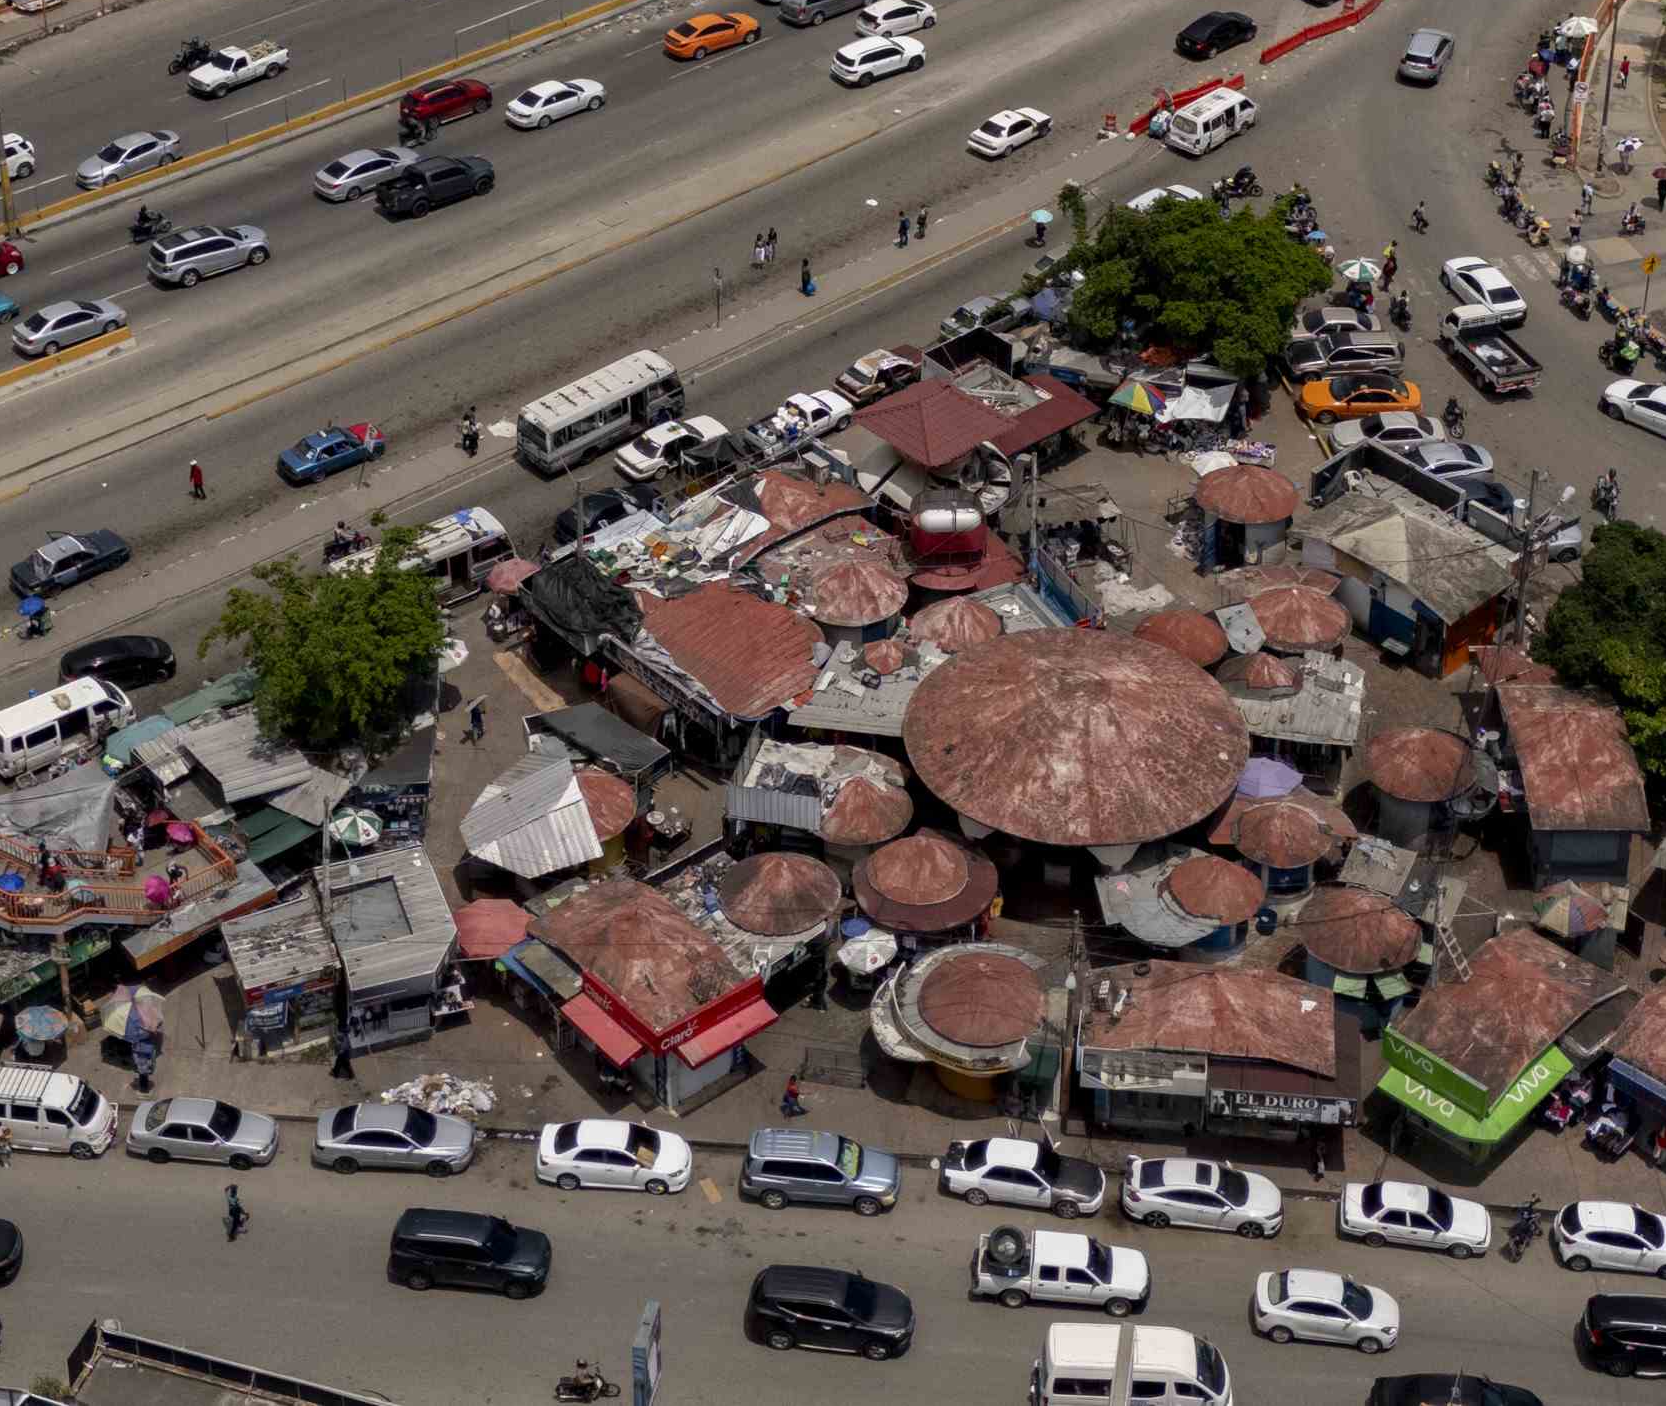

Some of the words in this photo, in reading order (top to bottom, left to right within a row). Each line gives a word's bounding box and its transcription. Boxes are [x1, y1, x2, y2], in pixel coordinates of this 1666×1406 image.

[661, 1024, 695, 1050] Claro
[1235, 1092, 1260, 1107] EL
[1264, 1095, 1319, 1110] DURO
